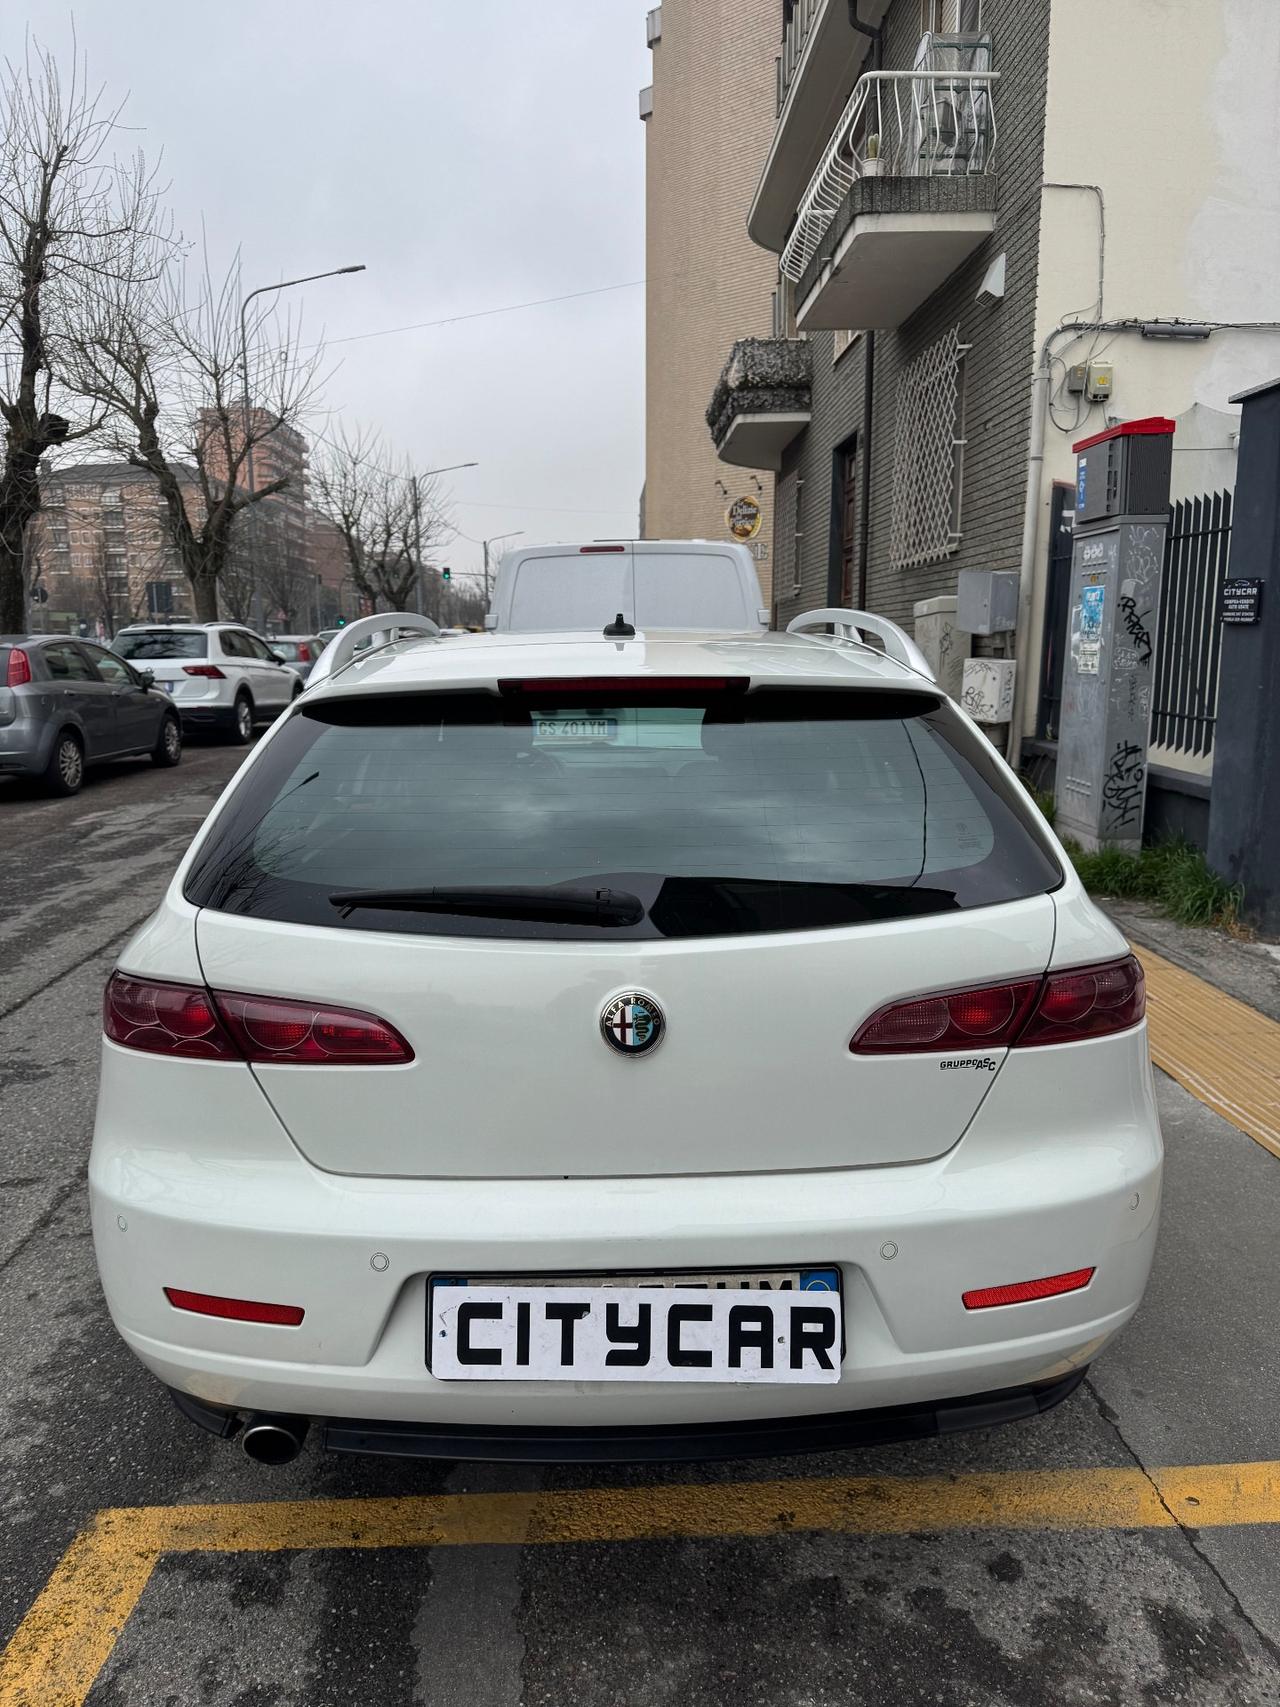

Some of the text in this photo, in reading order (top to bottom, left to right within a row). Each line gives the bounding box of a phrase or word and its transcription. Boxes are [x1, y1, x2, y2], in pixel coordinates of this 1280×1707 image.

[1223, 587, 1258, 596] CITYCAR
[540, 720, 556, 735] GS
[605, 997, 661, 1027] ALFA ROMEO
[457, 1302, 836, 1370] CITYCAR
